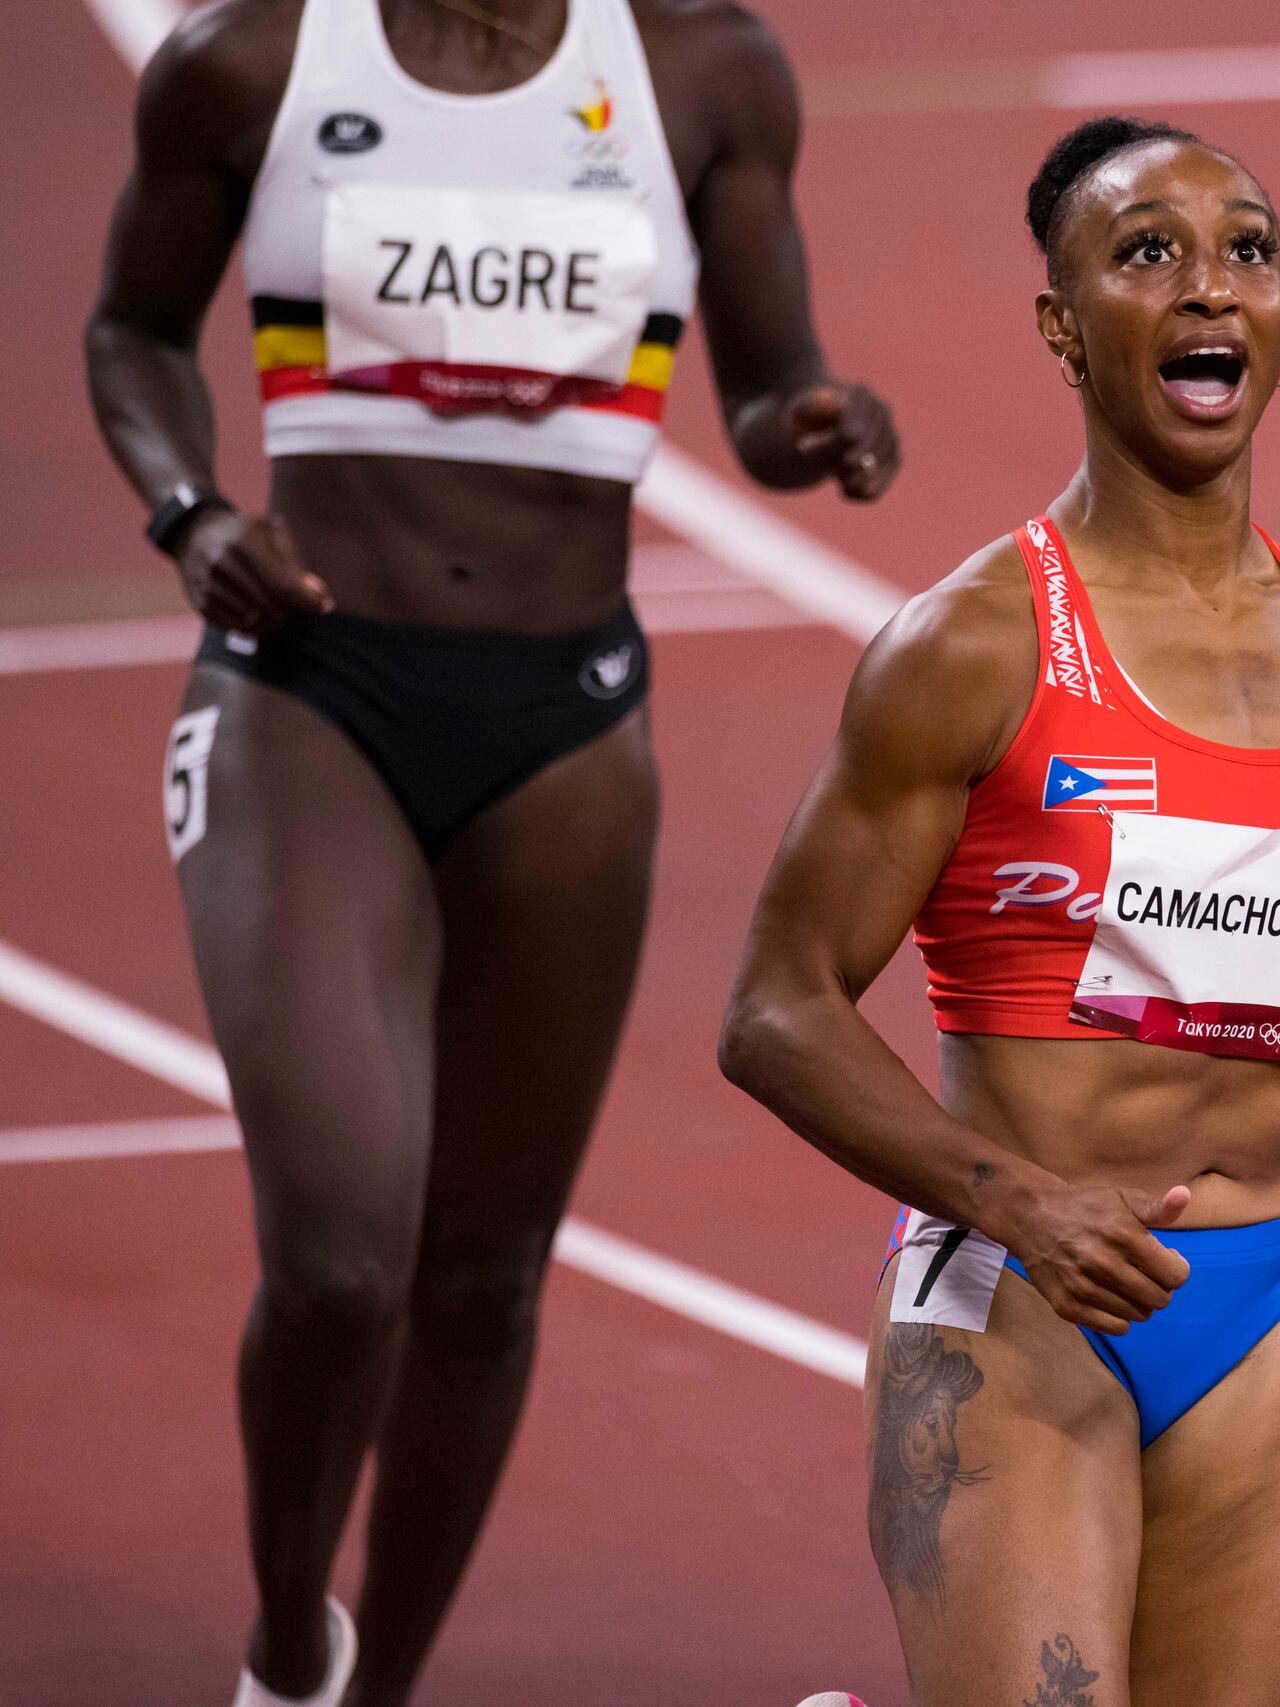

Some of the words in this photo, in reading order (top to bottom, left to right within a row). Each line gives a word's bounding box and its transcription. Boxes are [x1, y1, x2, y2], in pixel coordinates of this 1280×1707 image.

[378, 239, 600, 315] ZAGRE
[1177, 1018, 1221, 1037] TOKYO
[1221, 1024, 1256, 1040] 2020
